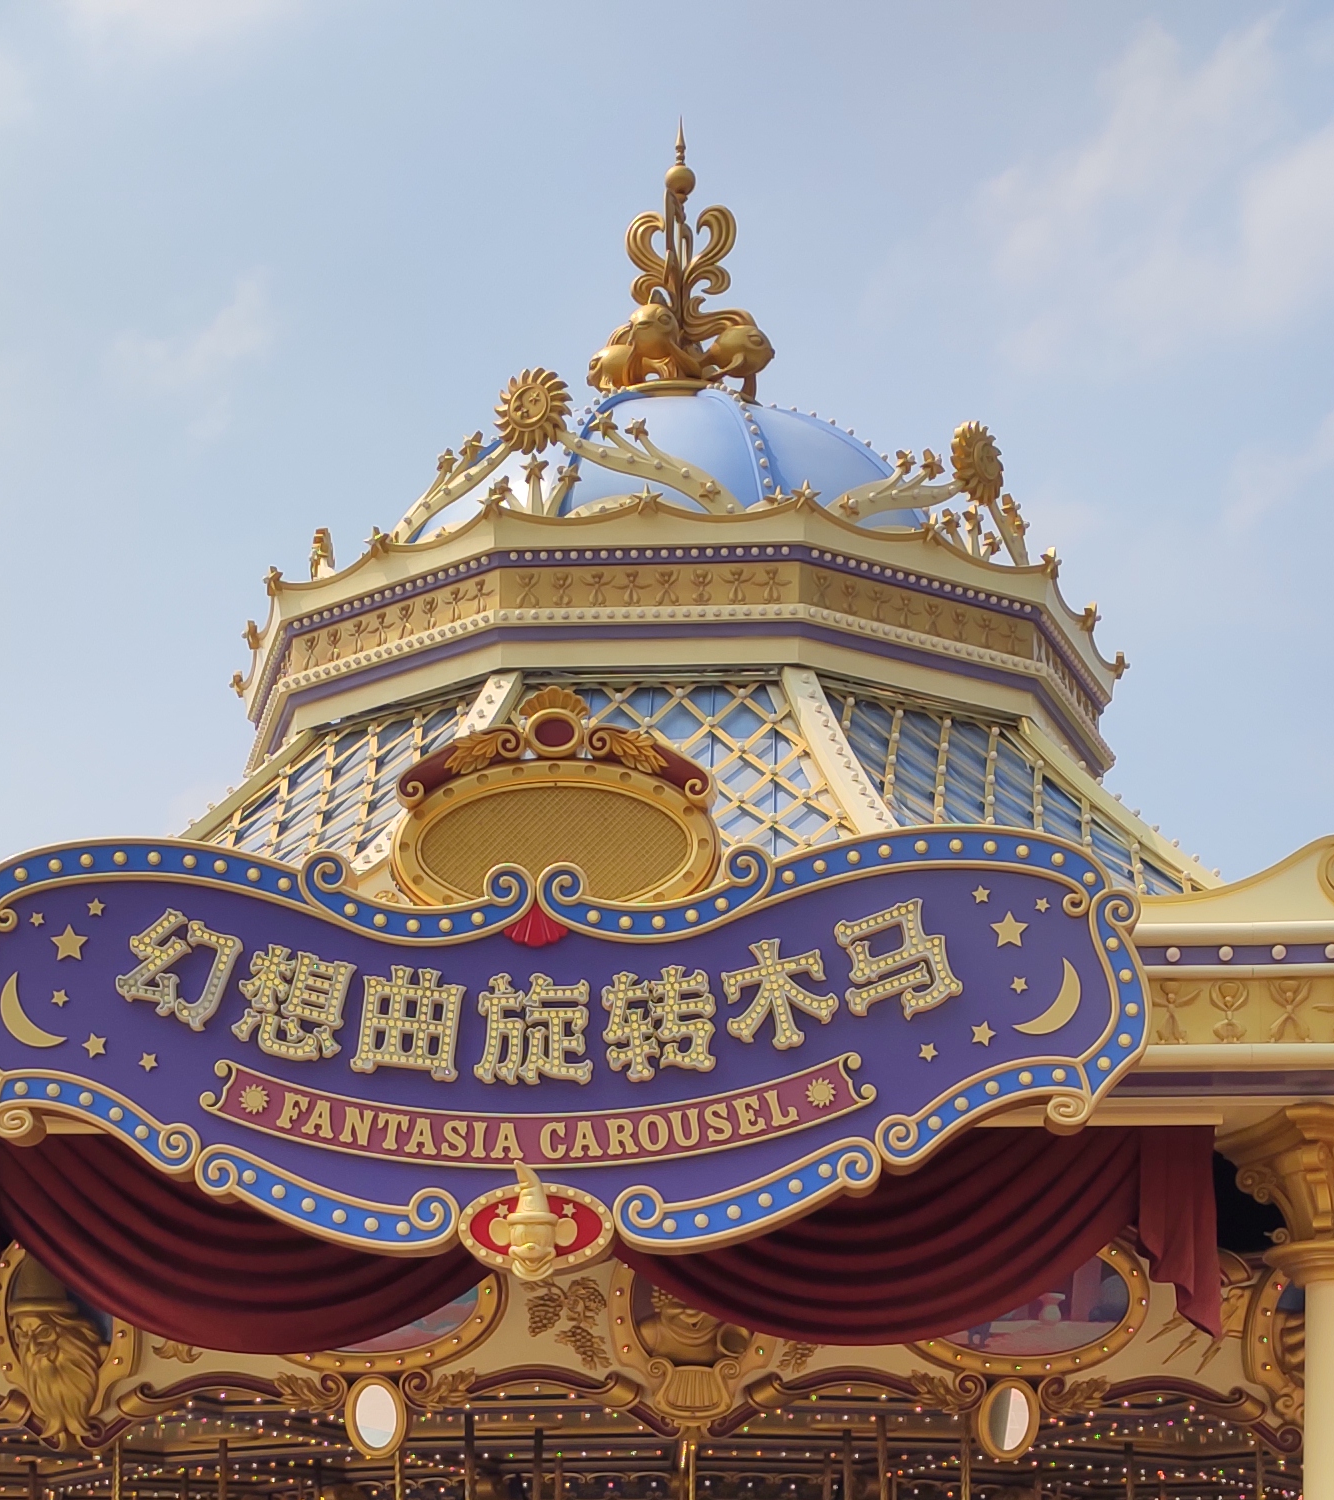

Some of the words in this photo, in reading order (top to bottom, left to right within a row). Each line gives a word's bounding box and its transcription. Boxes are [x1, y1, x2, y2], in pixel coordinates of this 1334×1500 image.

[115, 897, 964, 1086] 幻想曲旋转木马
[276, 1092, 524, 1159] FANTASIA
[539, 1089, 800, 1159] CAROUSEL
